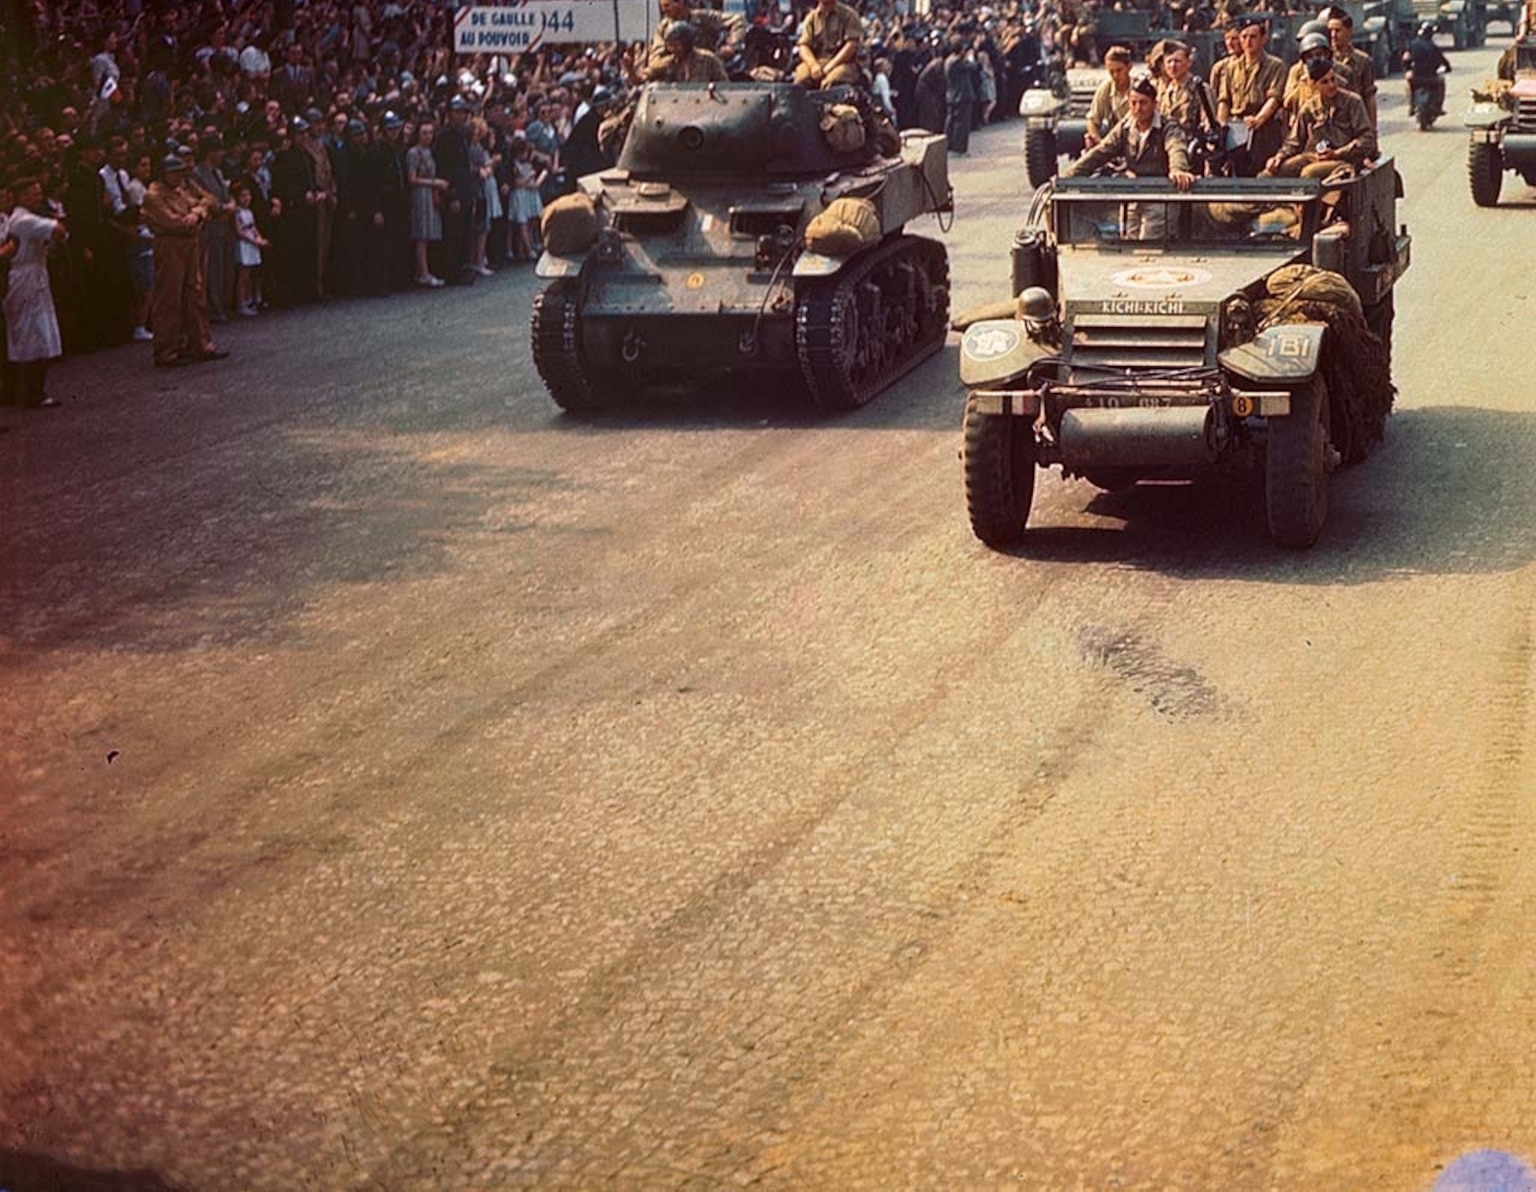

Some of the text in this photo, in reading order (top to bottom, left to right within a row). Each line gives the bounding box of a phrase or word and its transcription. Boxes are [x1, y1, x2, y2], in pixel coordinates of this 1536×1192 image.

[471, 11, 536, 26] DE GAULLE
[460, 31, 530, 46] AU POUVOIR
